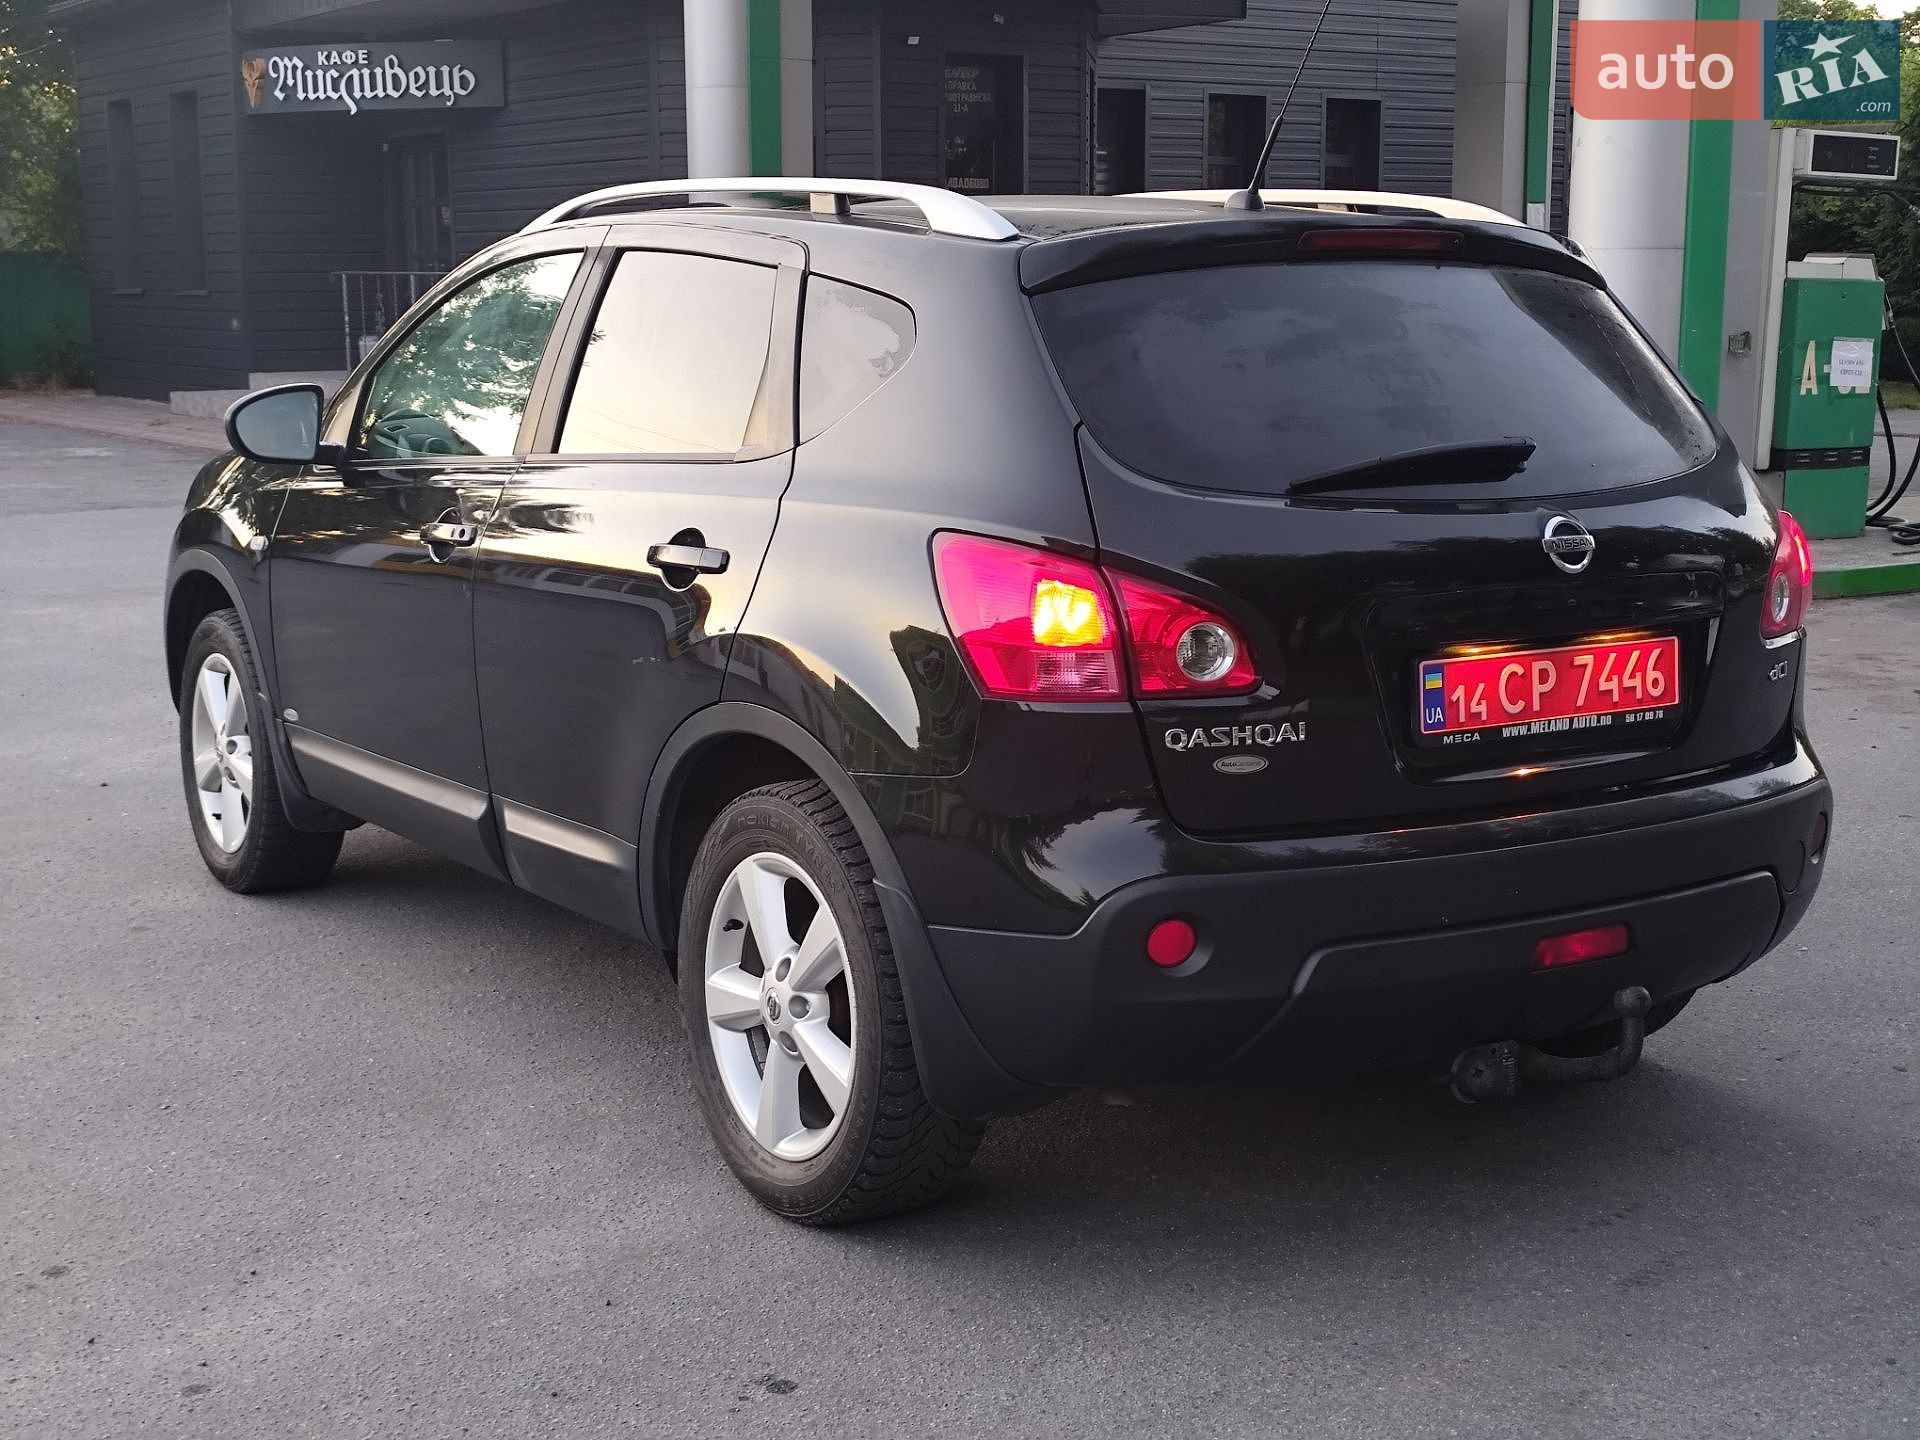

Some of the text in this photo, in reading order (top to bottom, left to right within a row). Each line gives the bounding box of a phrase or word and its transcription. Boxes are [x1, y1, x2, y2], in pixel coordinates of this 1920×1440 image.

[317, 49, 369, 66] КАФЕ
[268, 54, 476, 116] Мисливець
[1551, 537, 1593, 550] NISSAN
[1425, 647, 1666, 724] UA 14 CP 7446
[1164, 721, 1306, 752] QASHQAI
[1443, 732, 1481, 745] MECA
